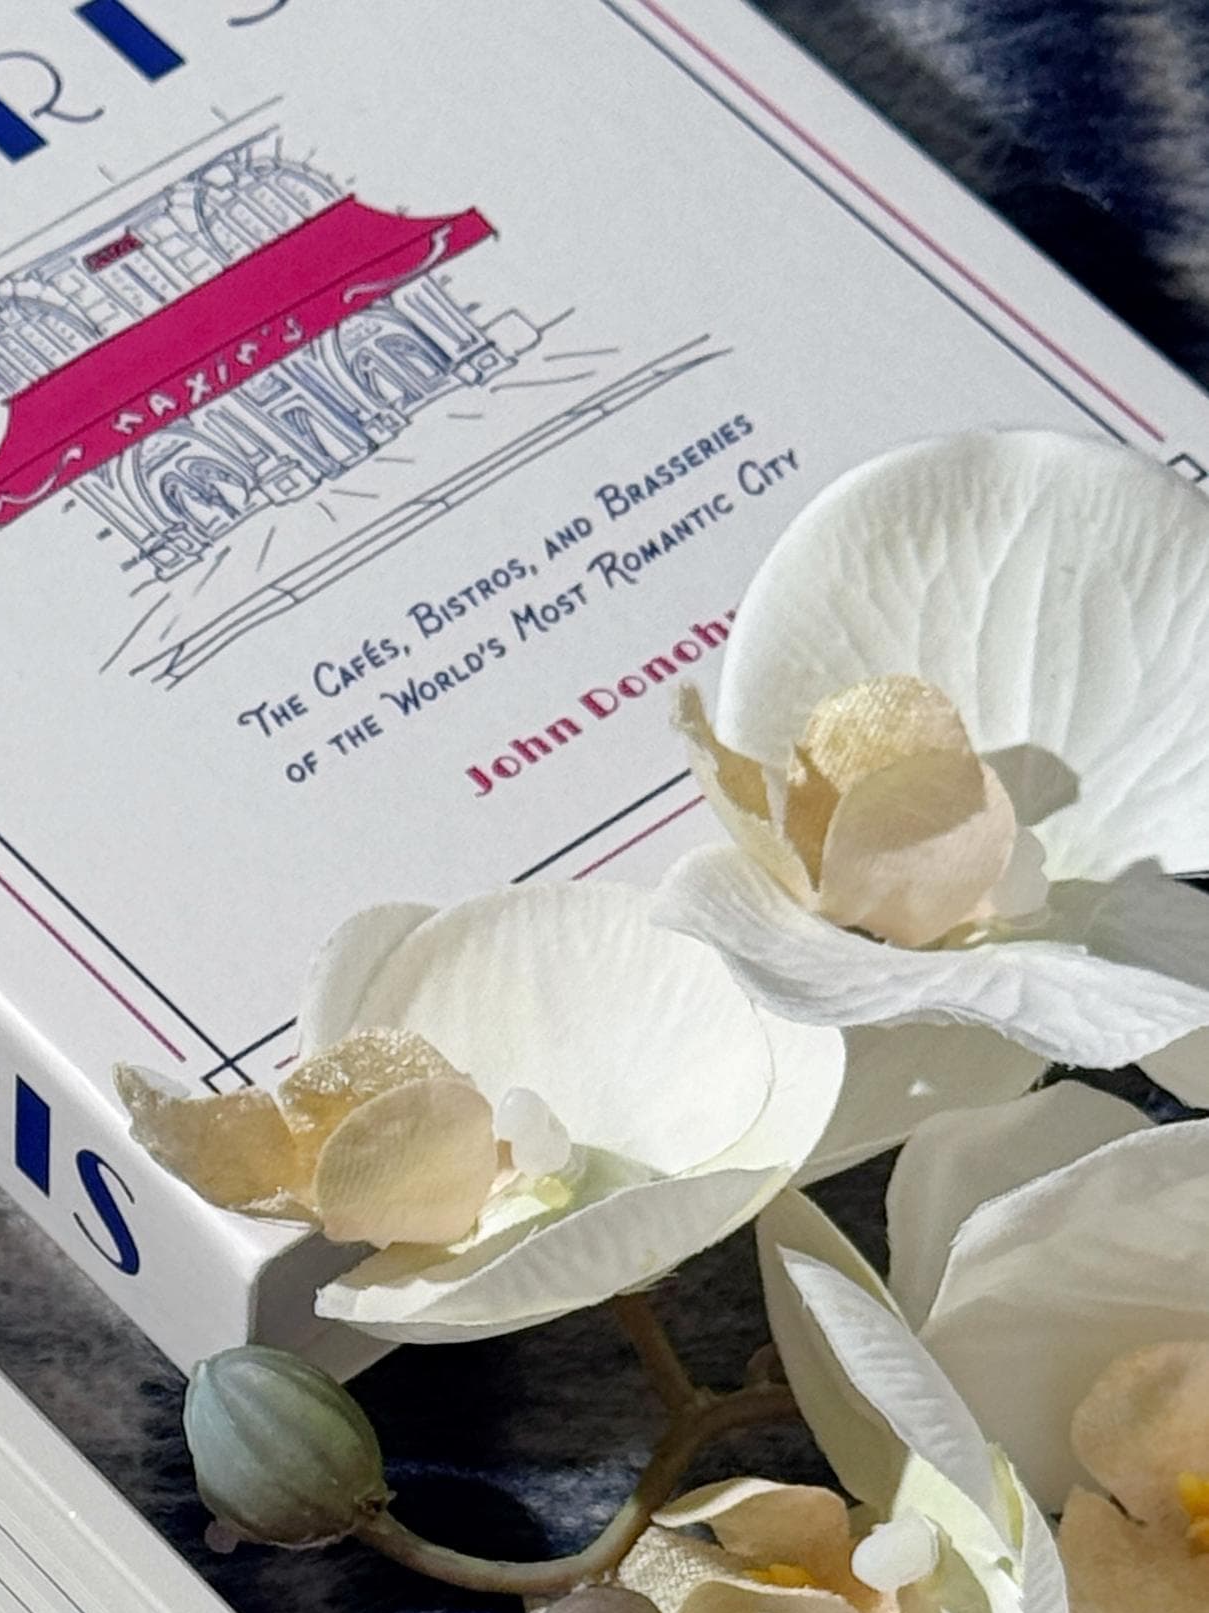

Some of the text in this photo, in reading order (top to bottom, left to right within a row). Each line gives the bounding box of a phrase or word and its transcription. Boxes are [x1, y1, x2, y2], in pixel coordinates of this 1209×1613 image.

[238, 412, 755, 739] THE CAFÉS, BISTROS, AND BRASSERIES
[285, 446, 801, 785] OF THE WORLD'S MOST ROMANTIC CITY
[464, 717, 583, 798] John
